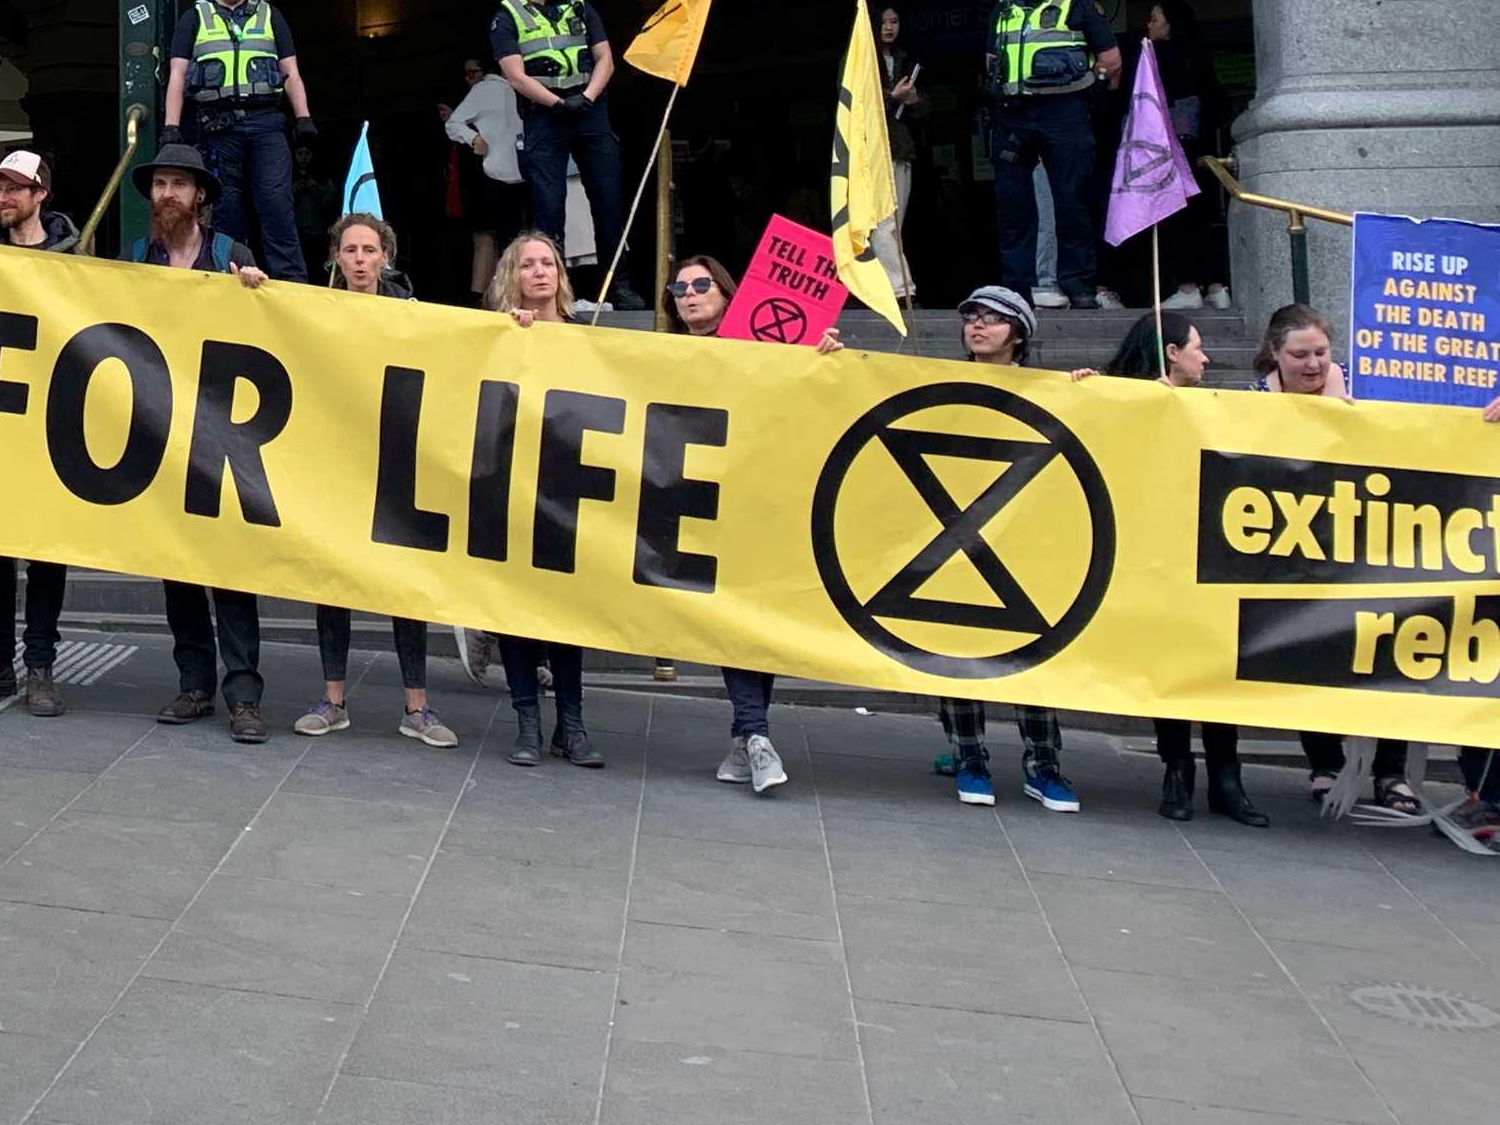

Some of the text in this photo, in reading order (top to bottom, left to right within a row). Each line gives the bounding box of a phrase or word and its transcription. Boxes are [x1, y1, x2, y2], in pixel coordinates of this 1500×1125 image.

[768, 235, 838, 280] TELL TH
[1392, 251, 1468, 275] RISE UP
[768, 261, 830, 301] TRUTH
[1384, 277, 1477, 304] AGAINST
[1374, 303, 1486, 332] THE DEATH
[1356, 328, 1500, 361] OF THE GREAT
[1358, 356, 1498, 388] BARRIER REEF
[371, 364, 729, 594] LIFE
